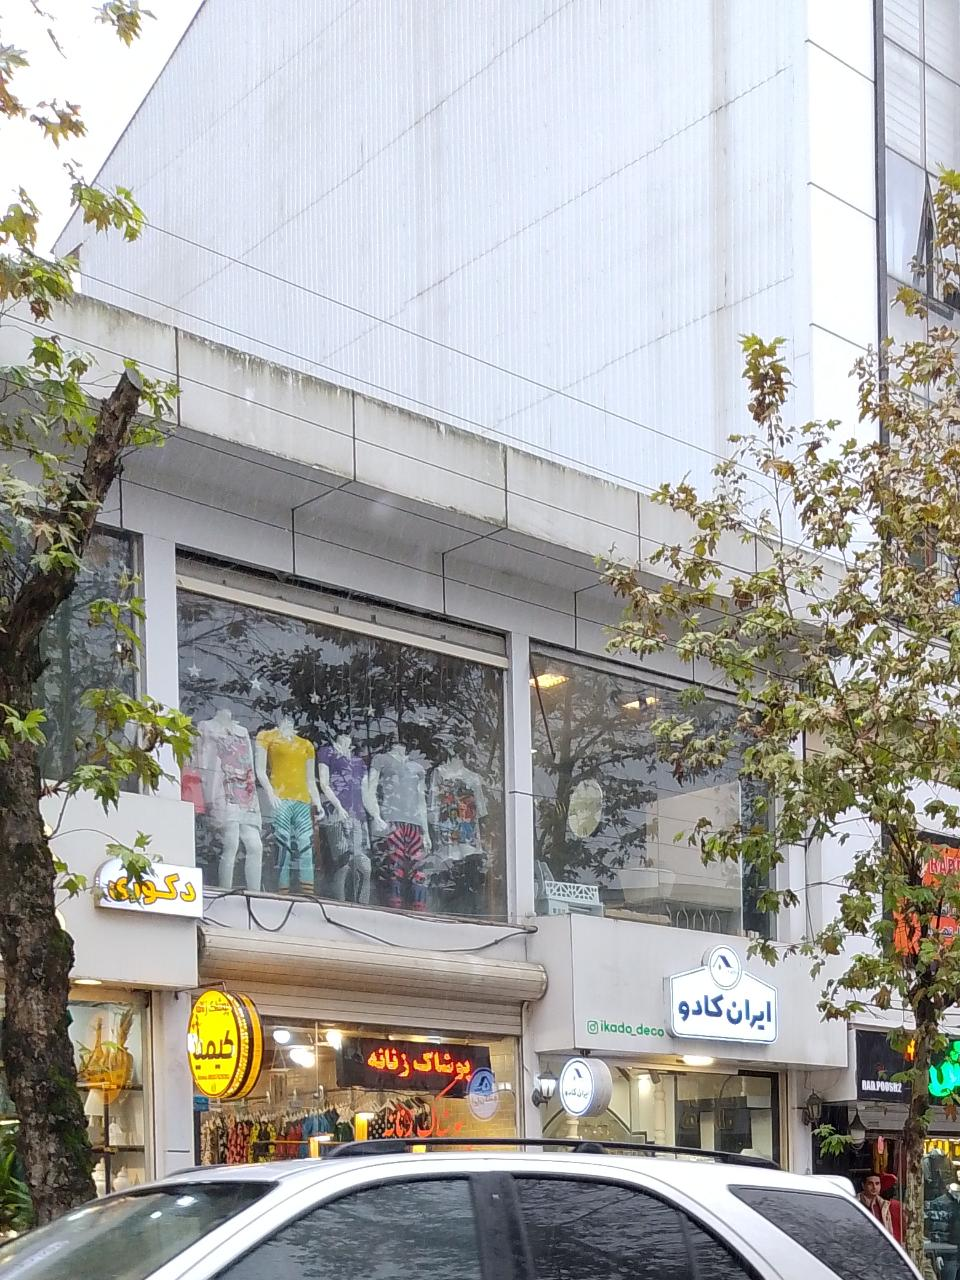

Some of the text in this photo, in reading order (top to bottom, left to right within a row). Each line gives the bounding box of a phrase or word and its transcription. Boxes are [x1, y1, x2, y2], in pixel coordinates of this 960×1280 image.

[678, 994, 772, 1030] ایران کادو
[601, 1021, 665, 1038] ikado_deco
[367, 1047, 472, 1081] پوشاک زنانه
